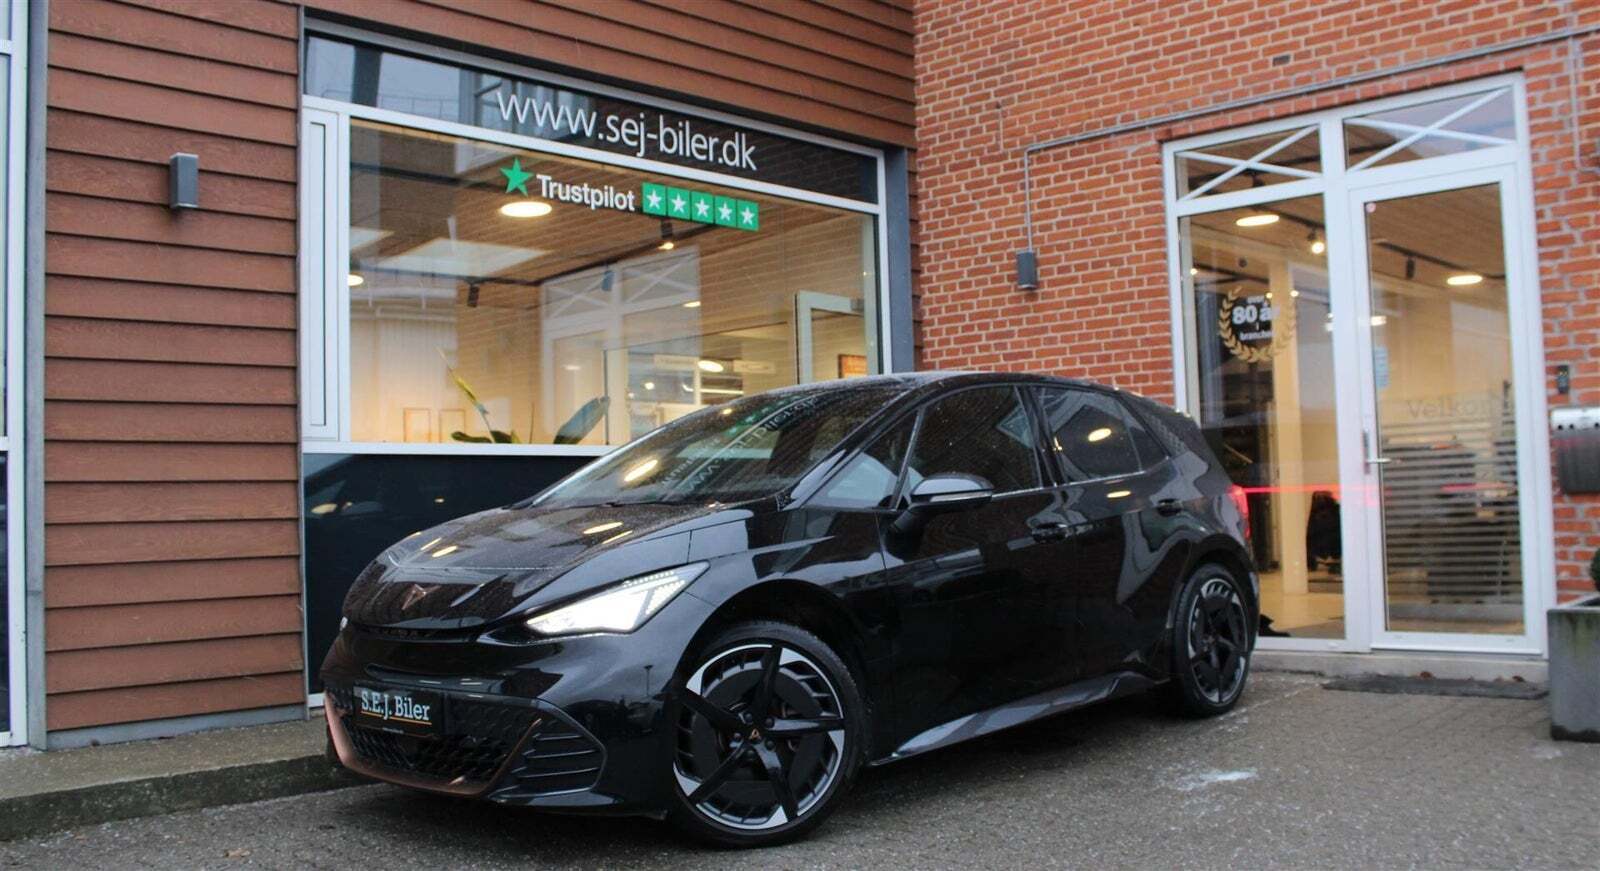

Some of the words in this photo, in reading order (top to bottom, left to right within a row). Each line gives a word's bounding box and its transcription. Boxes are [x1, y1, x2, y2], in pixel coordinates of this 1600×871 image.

[497, 92, 757, 171] www.sej-biler.dk
[536, 173, 636, 212] Trustpilot
[1232, 305, 1257, 325] 80
[361, 688, 392, 720] S.E.J.
[394, 695, 430, 721] Biler
